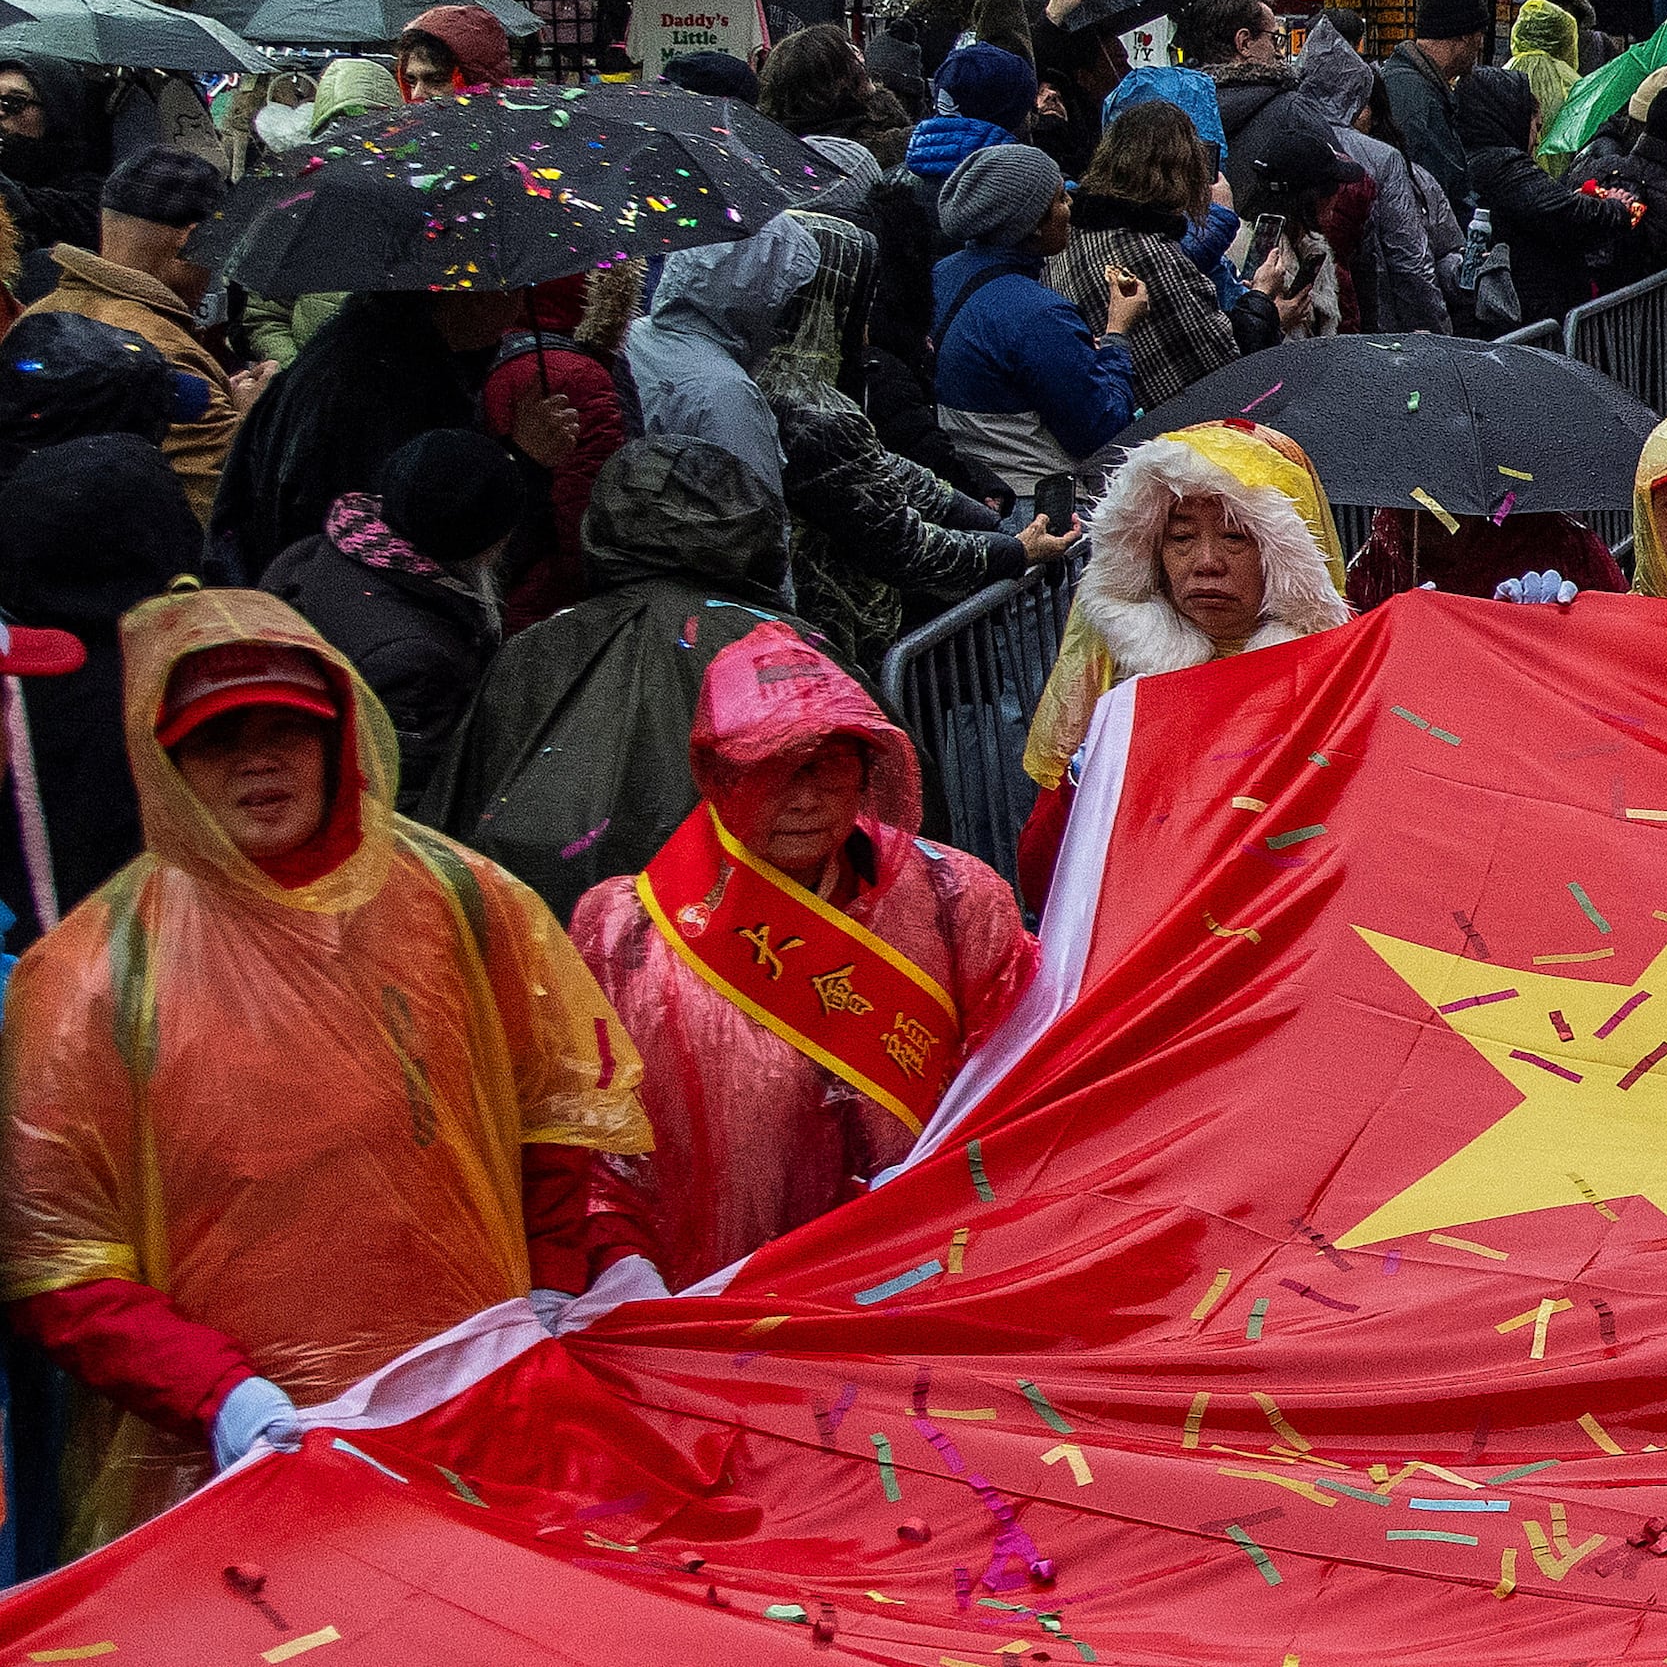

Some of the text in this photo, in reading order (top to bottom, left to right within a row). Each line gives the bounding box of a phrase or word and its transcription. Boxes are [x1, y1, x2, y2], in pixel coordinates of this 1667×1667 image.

[660, 12, 729, 31] Daddy's
[672, 29, 718, 46] Little
[739, 923, 941, 1081] 大會顧
